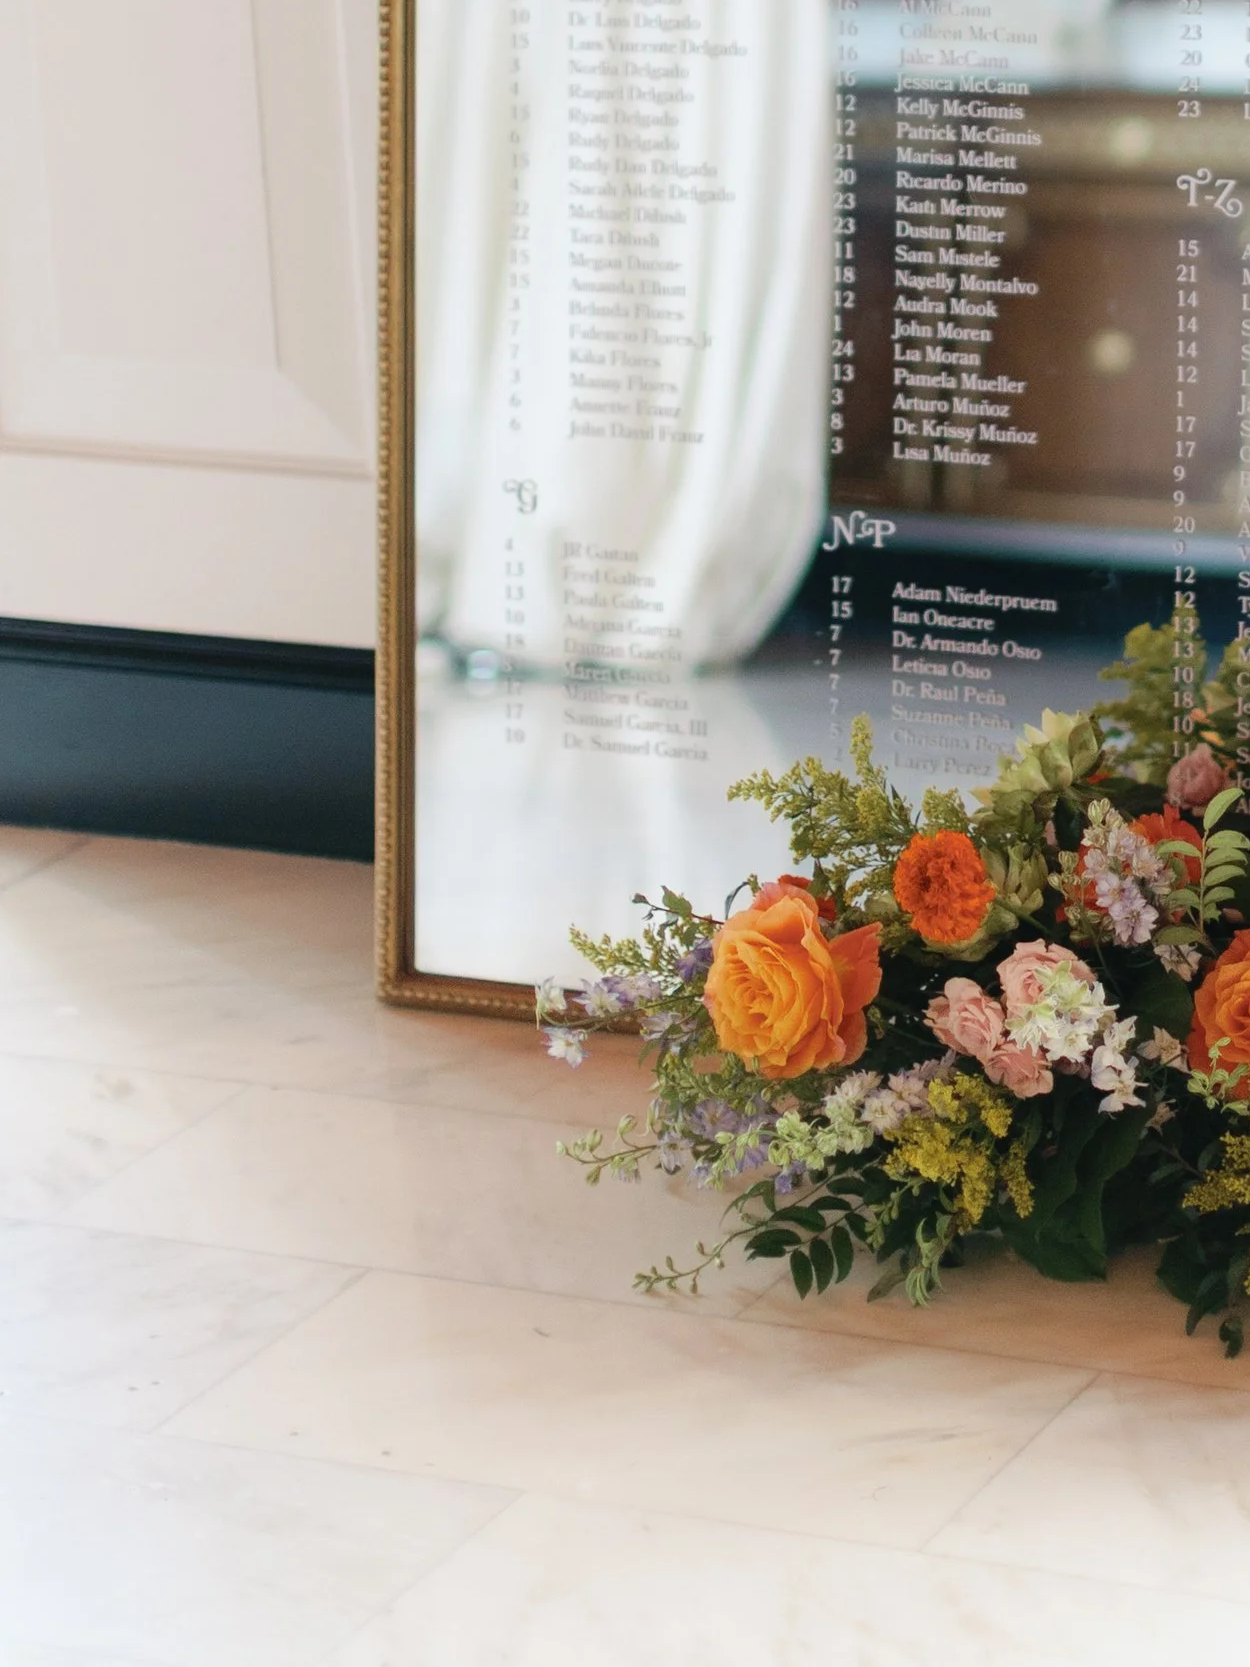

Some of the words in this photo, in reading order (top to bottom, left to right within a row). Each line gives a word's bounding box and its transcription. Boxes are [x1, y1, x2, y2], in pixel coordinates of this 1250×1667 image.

[1181, 25, 1202, 41] 23
[835, 95, 856, 111] 12
[896, 97, 939, 116] Kelly
[943, 100, 1025, 119] McGinnis
[1178, 101, 1200, 117] 23
[833, 144, 853, 160] 21
[896, 147, 954, 165] Marisa
[959, 151, 1017, 169] Mellett
[834, 169, 856, 184] 20
[896, 172, 962, 191] Ricardo
[966, 175, 1028, 194] Merino
[1177, 169, 1242, 217] T-Z
[832, 218, 856, 233] 23
[896, 221, 952, 239] Dustin
[955, 223, 1005, 243] Miller
[834, 242, 853, 259] 11
[895, 245, 934, 263] Sam
[938, 248, 1000, 267] Mistele
[834, 267, 855, 283] 18
[895, 270, 956, 292] Nayelly
[960, 274, 1038, 295] Montalvo
[834, 315, 841, 331] 1
[891, 319, 932, 339] John
[937, 322, 992, 341] Moren
[833, 365, 854, 381] 13
[894, 369, 957, 388] Pamela
[960, 373, 1027, 393] Mueller
[832, 389, 843, 405] 3
[893, 394, 949, 412] Arturo
[952, 397, 1011, 417] Muñoz
[831, 413, 844, 429] 8
[893, 417, 917, 435] Dr.
[922, 419, 976, 442] Krissy
[980, 423, 1038, 444] Muñoz
[832, 437, 843, 453] 3
[893, 442, 929, 460] Lisa
[933, 444, 992, 465] Muñoz
[1173, 491, 1185, 507] 9
[1173, 516, 1195, 532] 20
[1173, 566, 1195, 583] 12
[831, 577, 852, 593] 17
[892, 582, 941, 601] Adam
[946, 585, 1057, 611] Niederpruem
[832, 601, 852, 618] 15
[892, 607, 920, 623] Ian
[924, 609, 994, 631] Oneacre
[1174, 616, 1195, 633] 13
[830, 625, 842, 641] 7
[892, 632, 916, 647] Dr.
[920, 634, 998, 655] Armando
[1002, 641, 1042, 660] Osio
[830, 650, 842, 665] 7
[892, 655, 947, 676] Leticia
[952, 661, 991, 680] Osio
[1173, 667, 1194, 683] 10
